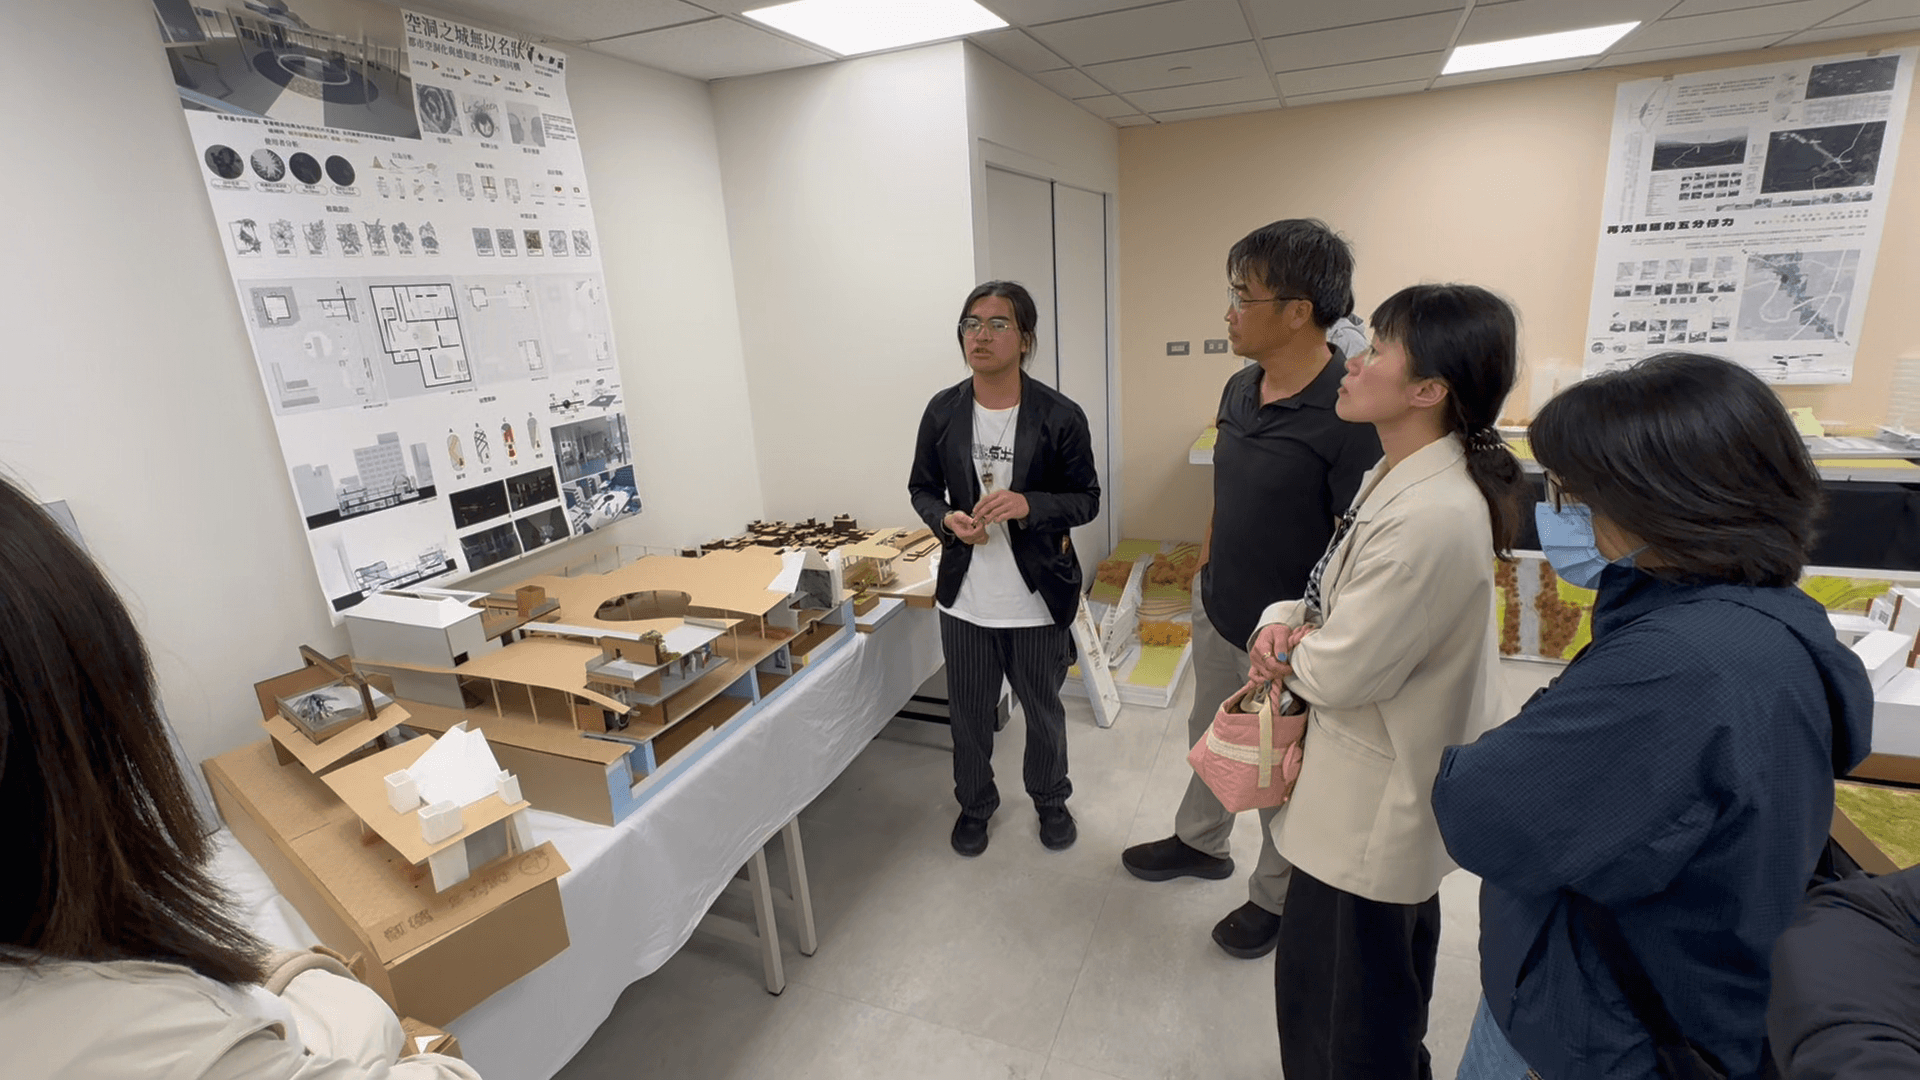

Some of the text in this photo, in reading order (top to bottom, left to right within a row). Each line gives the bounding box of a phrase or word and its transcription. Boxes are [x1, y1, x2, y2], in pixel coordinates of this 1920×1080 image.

[405, 12, 526, 61] 空洞之城無以名狀
